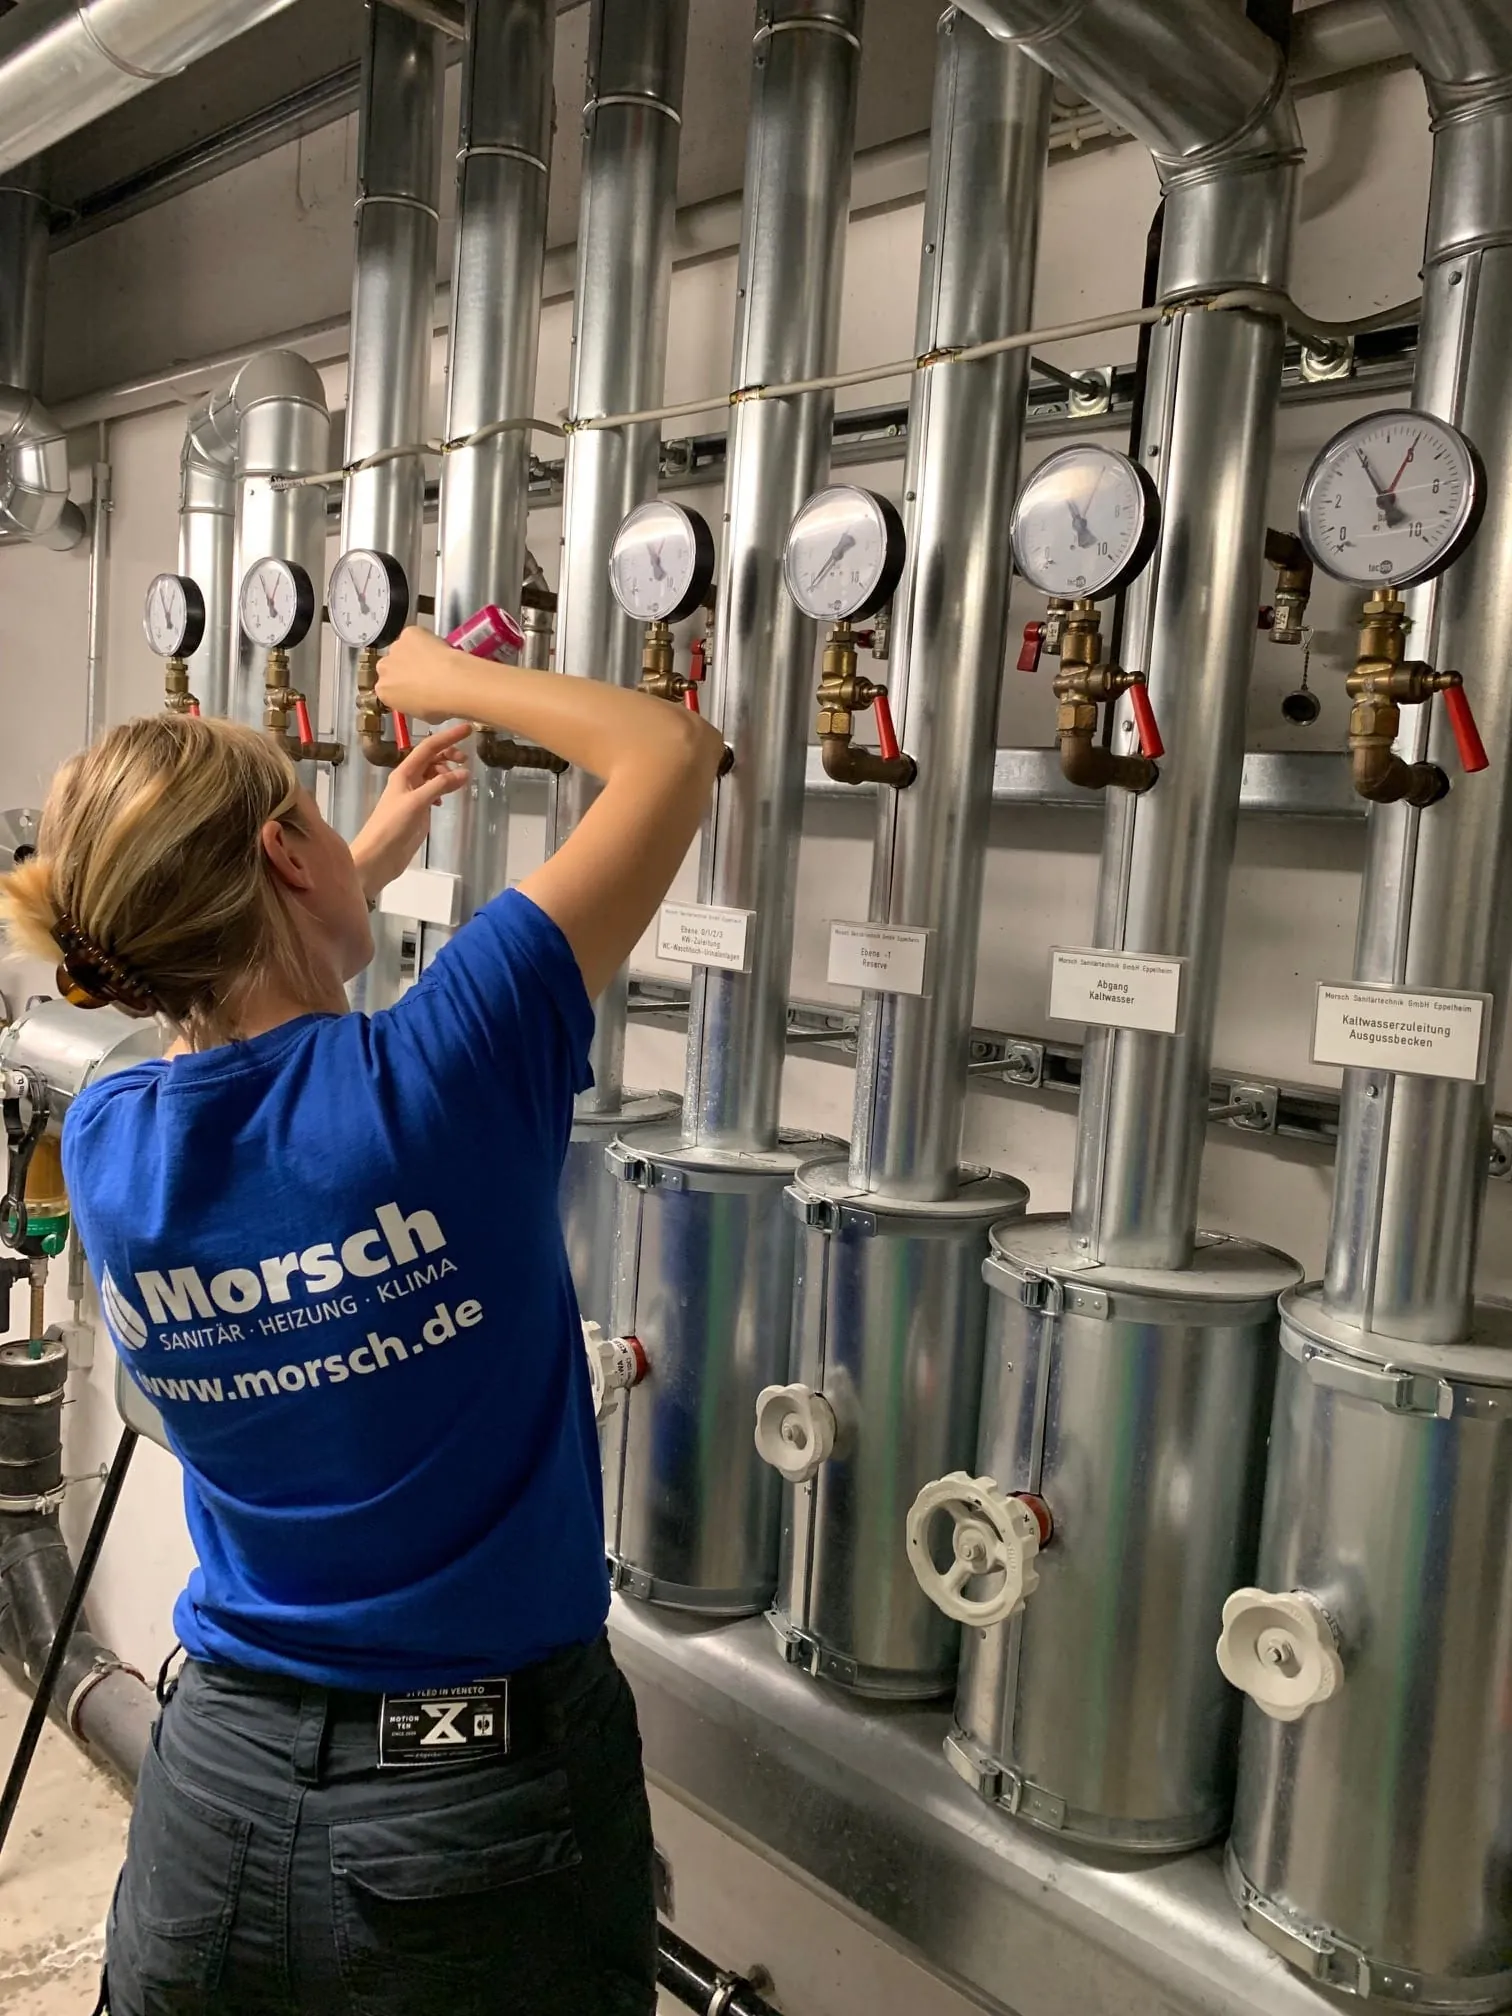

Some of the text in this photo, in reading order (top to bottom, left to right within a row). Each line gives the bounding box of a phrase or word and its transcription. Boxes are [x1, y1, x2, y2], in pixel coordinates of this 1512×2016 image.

[1432, 478, 1440, 495] 8
[1334, 494, 1342, 509] 2
[1339, 526, 1347, 541] 0
[1408, 521, 1422, 538] 10
[1097, 541, 1108, 556] 10
[861, 947, 880, 958] Ebene
[862, 958, 888, 970] Reserve
[1096, 979, 1129, 993] Abgang
[1089, 990, 1135, 1005] Kaltwasser
[1325, 991, 1350, 1001] Morsch
[1408, 999, 1430, 1009] GmbH
[1433, 1001, 1472, 1013] Eppelheim
[1342, 1014, 1451, 1038] Kaltwasserzuleitung
[1349, 1029, 1433, 1048] Ausgussbecken
[133, 1201, 448, 1325] Morsch
[158, 1257, 458, 1351] SANITÄR HEIZUNG KLIMA
[135, 1298, 484, 1402] www.morsch.de
[451, 1686, 485, 1695] VENETO
